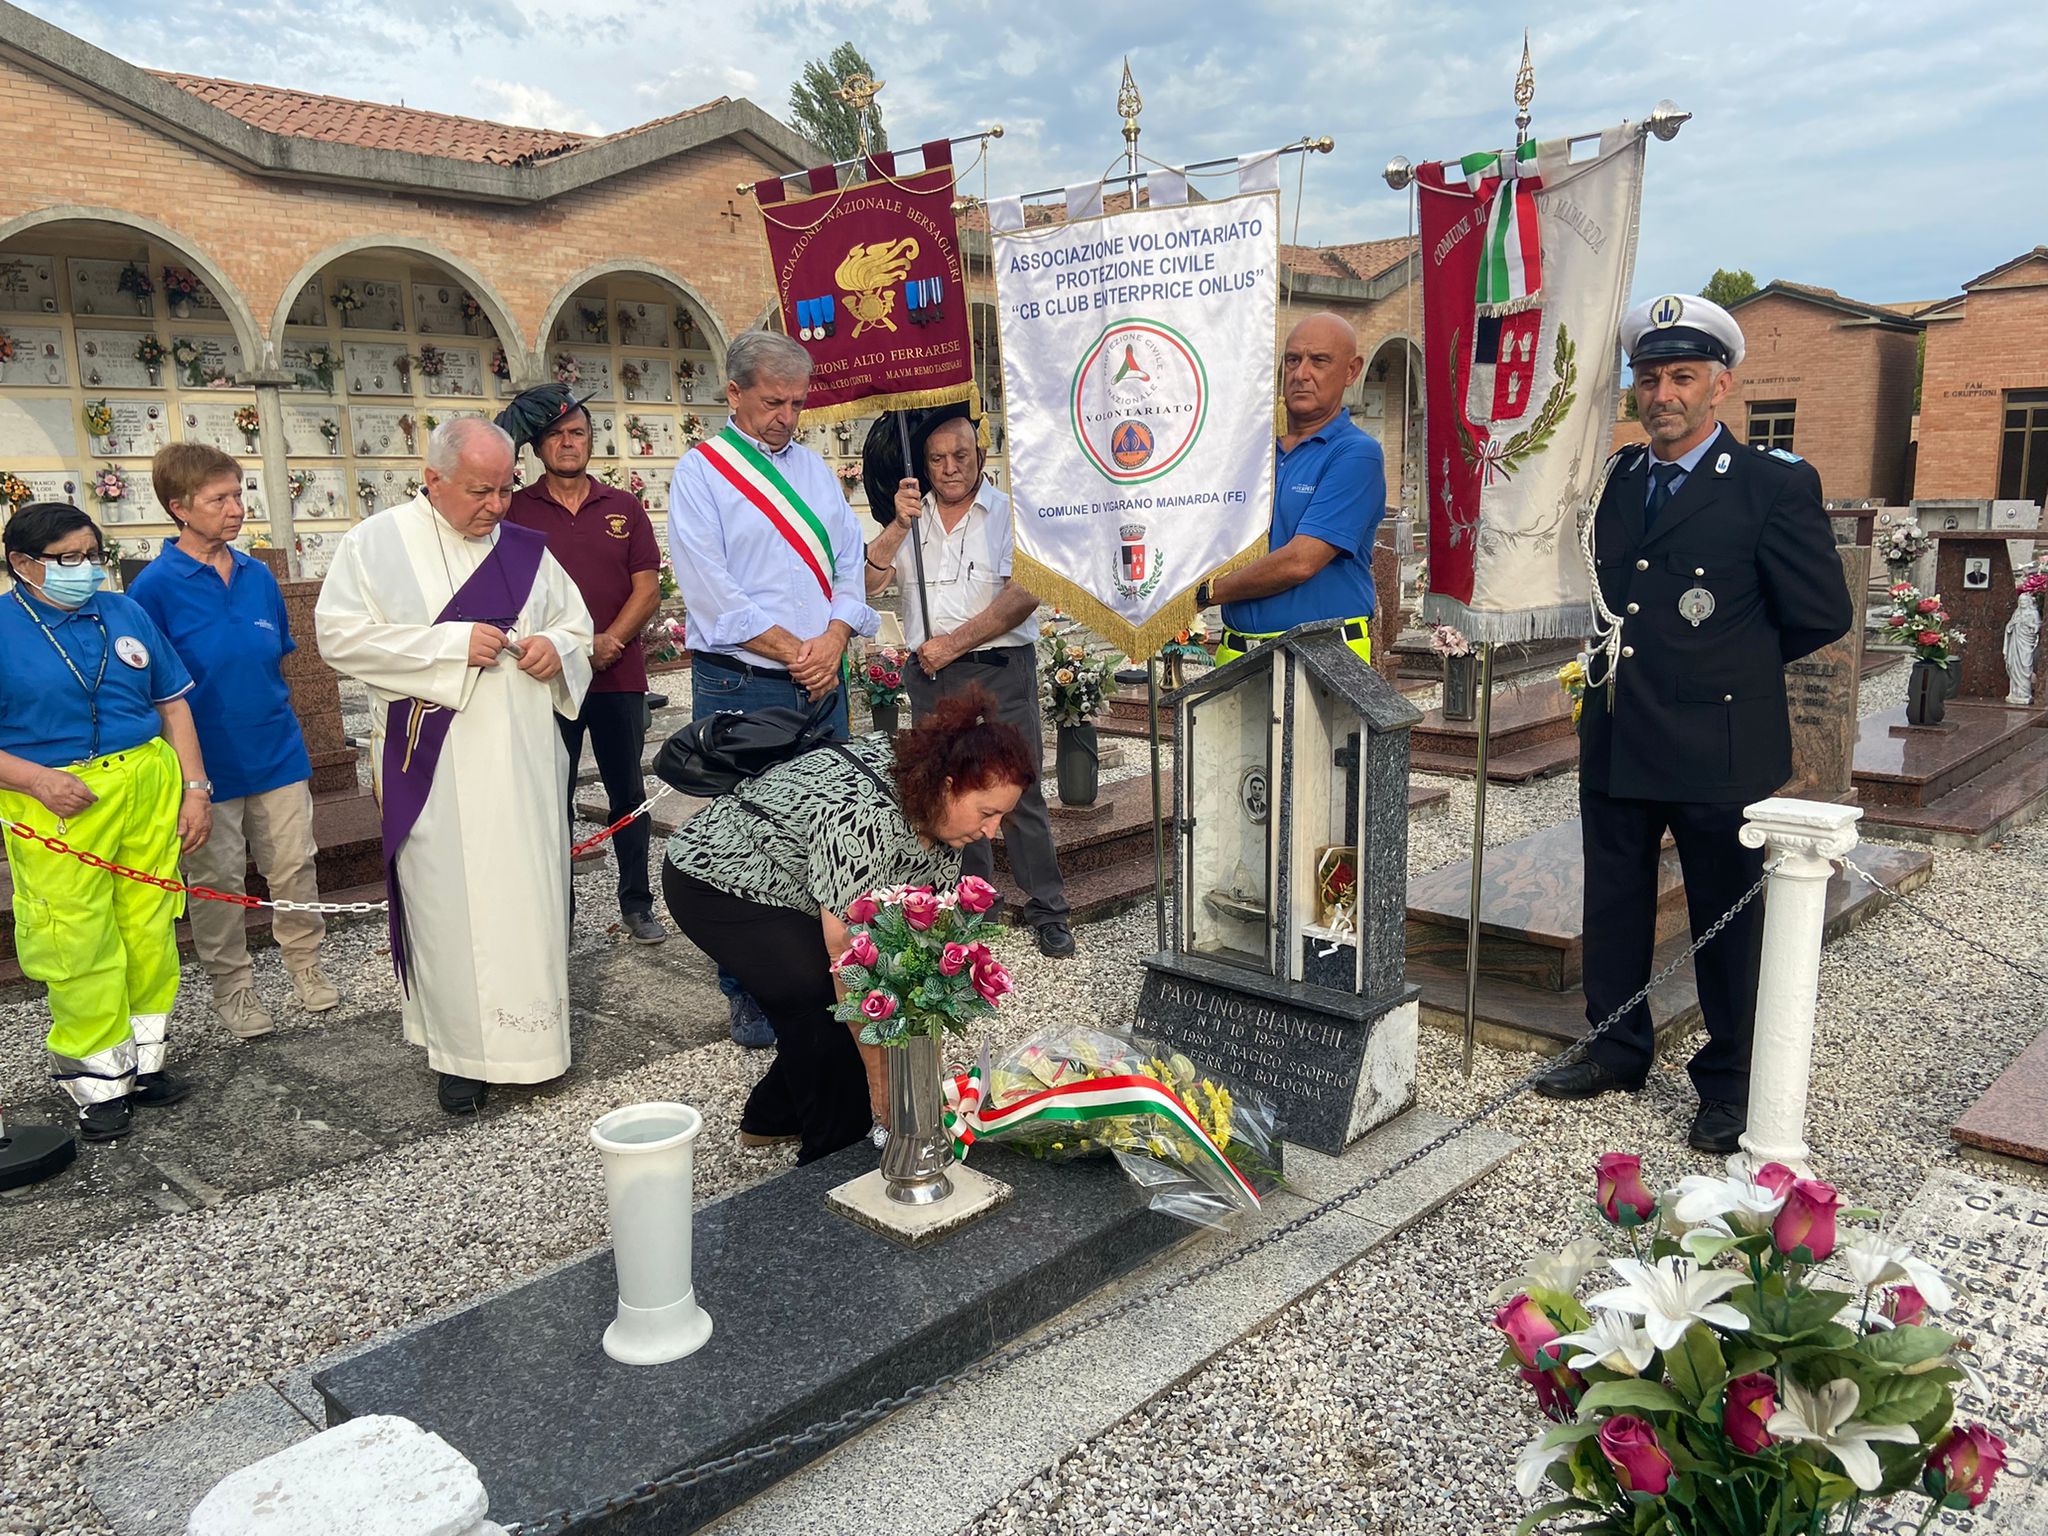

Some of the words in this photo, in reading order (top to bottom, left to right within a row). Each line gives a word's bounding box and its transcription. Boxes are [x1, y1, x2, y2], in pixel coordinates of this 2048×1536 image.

[825, 197, 903, 224] NAZIONALE
[906, 206, 961, 284] BERSAGLIERI
[1010, 237, 1124, 274] ASSOCIAZIONE
[1128, 219, 1263, 252] VOLONTARIATO
[1432, 215, 1472, 267] COMUNE
[1473, 203, 1488, 226] DI
[1055, 258, 1154, 291] PROTEZIONE
[1159, 252, 1215, 274] CIVILE
[1045, 294, 1089, 316] CLUB
[1093, 281, 1193, 309] ENTERPRICE
[808, 358, 850, 376] ZIONE
[853, 353, 885, 368] ALTO
[890, 340, 961, 361] FERRARESE
[913, 365, 934, 376] REMO
[1144, 339, 1164, 370] CIVILE
[1106, 383, 1158, 405] NAZIONALE
[1085, 403, 1194, 423] VOLONTARIATO
[1038, 503, 1089, 518] COMUNE
[1091, 502, 1102, 514] DI
[1103, 497, 1153, 513] VIGARANO
[1156, 492, 1220, 509] MAINARDA
[1223, 490, 1247, 506] (FE)
[1197, 1014, 1207, 1027] N
[1230, 1023, 1245, 1037] 10
[1256, 1008, 1344, 1048] BIANCHI
[1135, 1015, 1146, 1029] M
[1149, 1020, 1159, 1032] 2
[1165, 1024, 1175, 1036] 8
[1182, 1029, 1213, 1047] 1980
[1221, 1040, 1282, 1068] TRAGICO
[1287, 1060, 1349, 1088] SCOPPIO
[1231, 1061, 1246, 1077] DI
[1254, 1068, 1322, 1101] BOLOGNA
